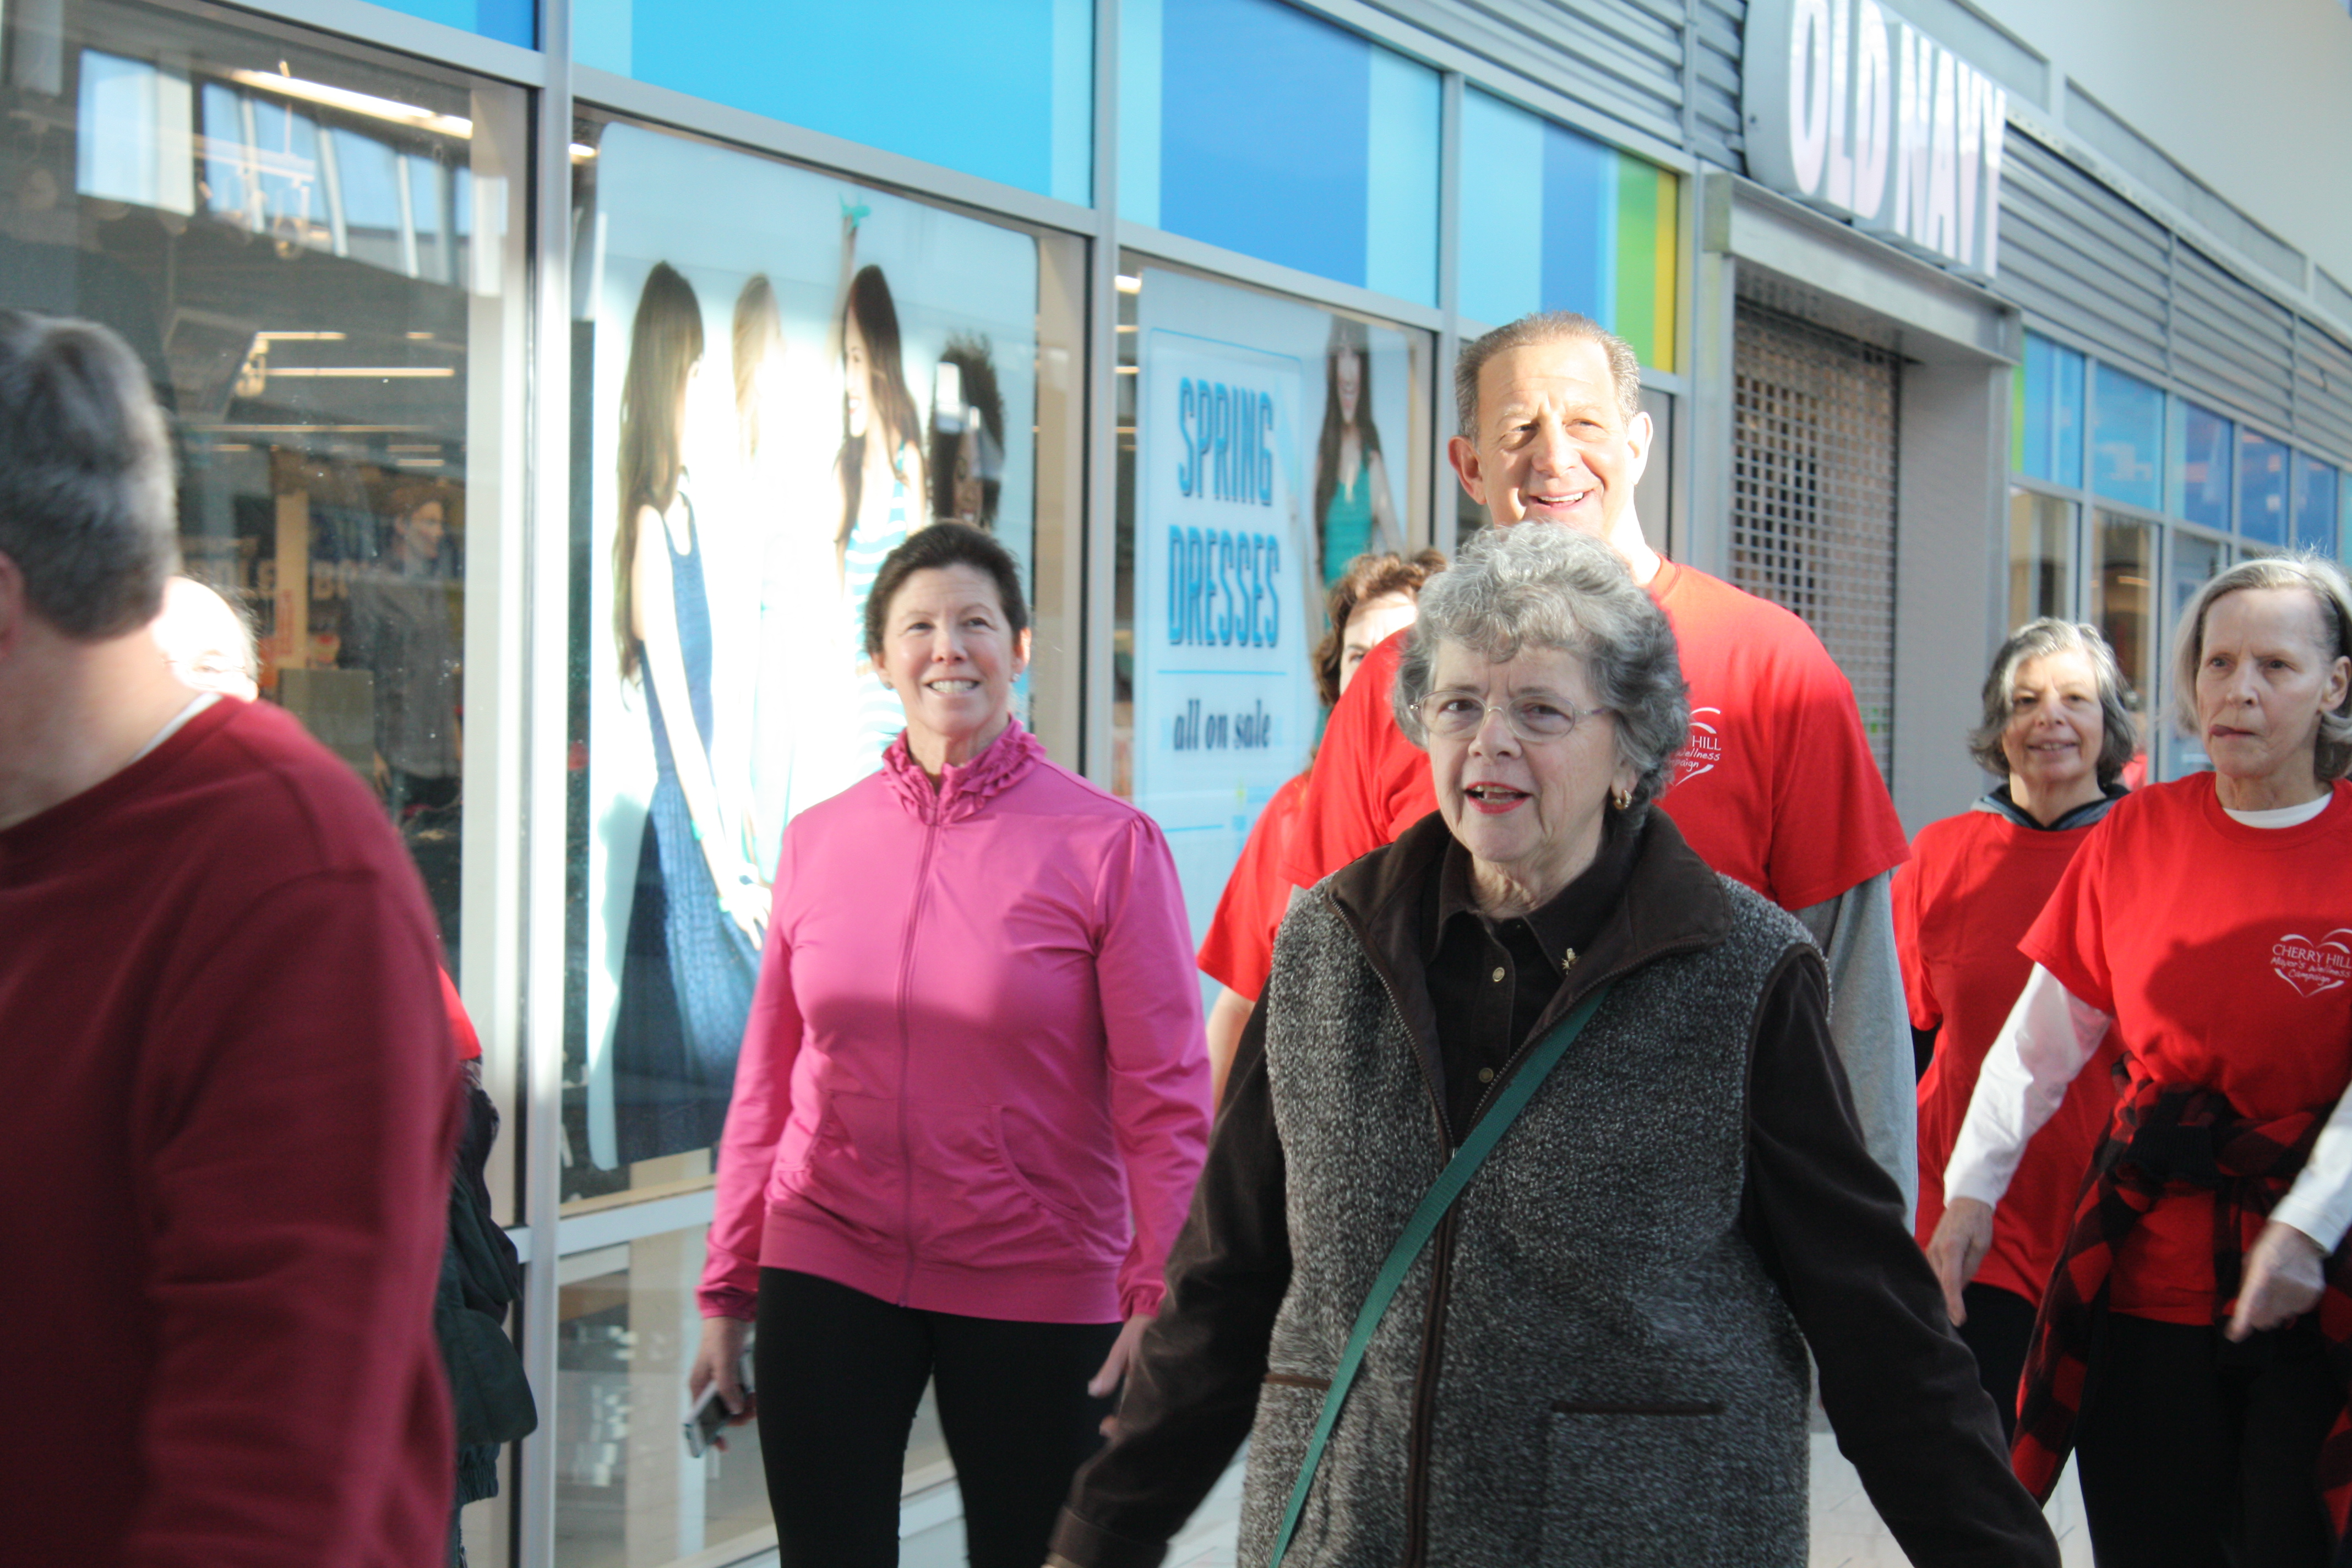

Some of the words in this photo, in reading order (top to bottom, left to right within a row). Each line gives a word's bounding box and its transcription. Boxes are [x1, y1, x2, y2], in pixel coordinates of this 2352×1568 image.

[1789, 0, 1890, 220] OLD
[1893, 21, 2007, 280] NAVY
[1178, 377, 1273, 507] SPRING
[1168, 524, 1280, 648] DRESSES
[1174, 699, 1200, 750] all
[1206, 713, 1228, 750] on
[1235, 699, 1271, 750] sale
[1692, 735, 1722, 751] HILL
[2272, 943, 2324, 963] CHERRY
[2326, 952, 2352, 970] HILL
